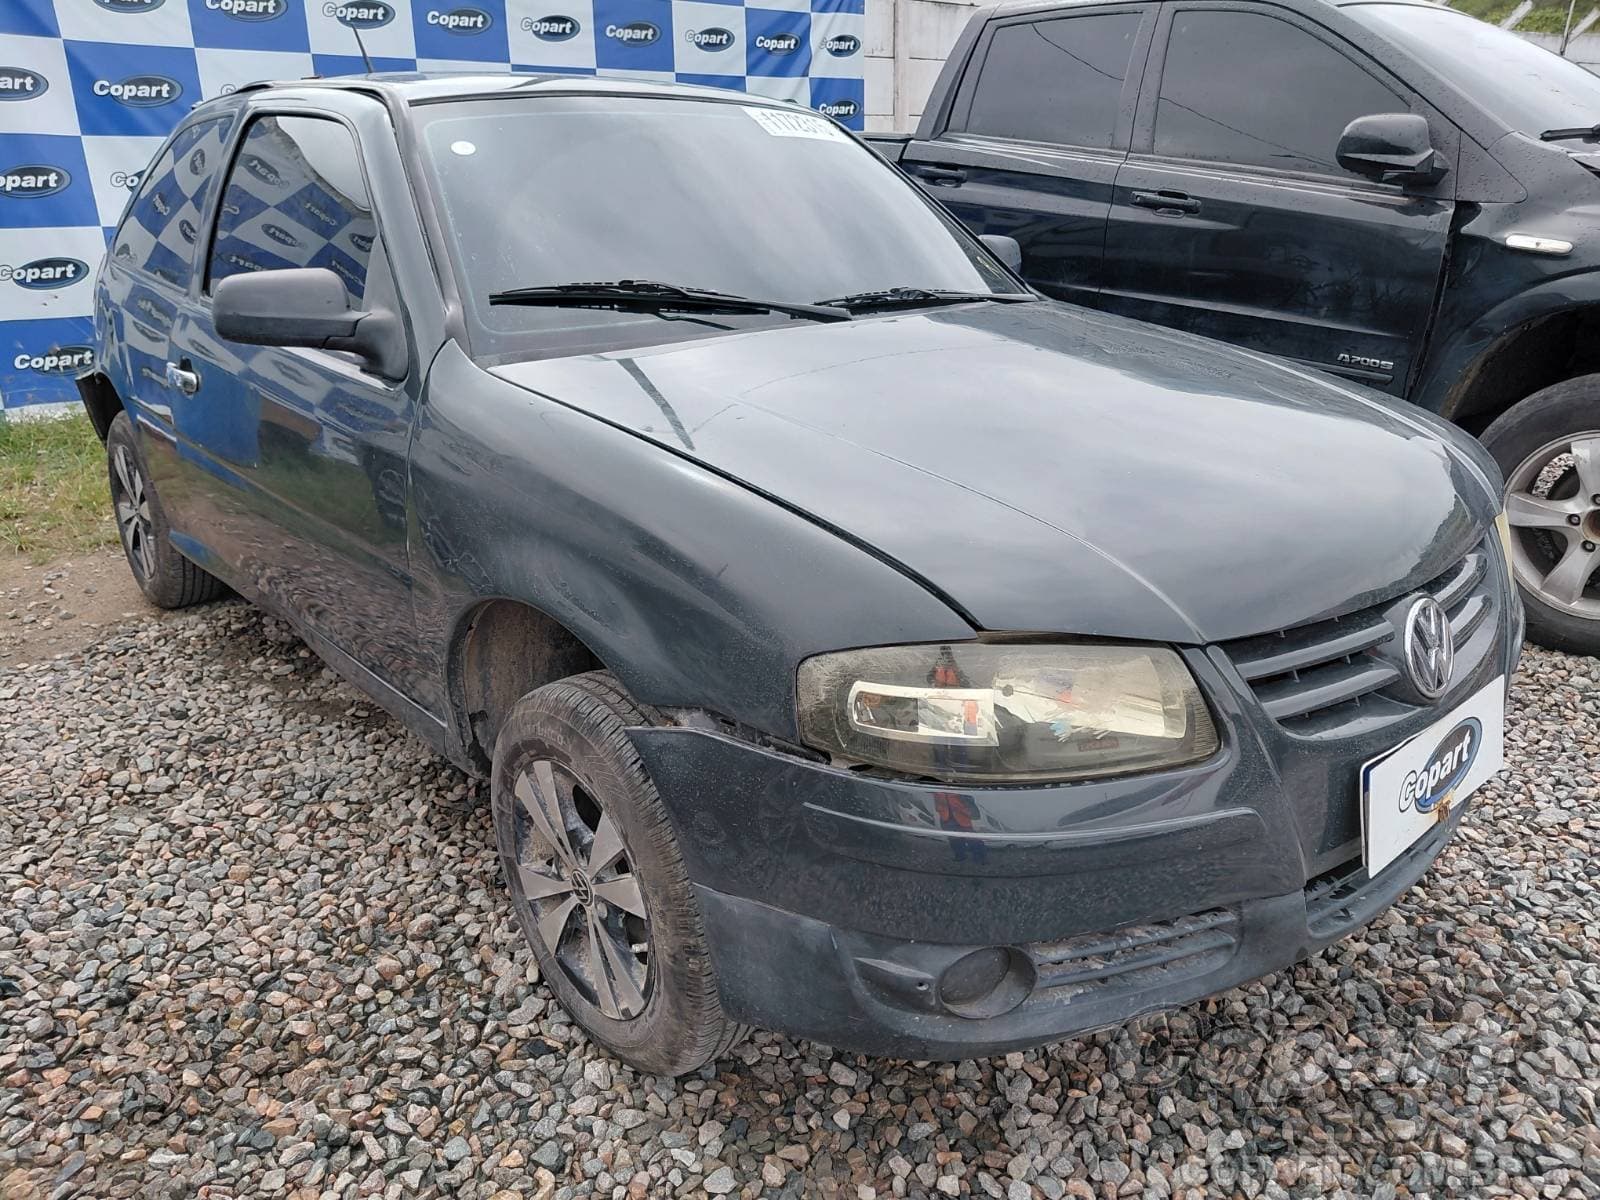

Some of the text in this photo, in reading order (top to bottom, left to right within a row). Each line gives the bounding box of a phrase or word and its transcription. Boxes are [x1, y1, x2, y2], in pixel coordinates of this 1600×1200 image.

[206, 0, 276, 14] Copart
[321, 1, 386, 20] Copart
[426, 11, 485, 28] Copart
[520, 18, 573, 35] Copart
[606, 25, 655, 41] Copart
[684, 29, 729, 46] Copart
[755, 36, 796, 51] Copart
[820, 38, 854, 51] Copart
[0, 76, 34, 91] art
[94, 80, 170, 98] Copart
[818, 103, 854, 118] Copart
[0, 263, 75, 282] Copart
[14, 352, 94, 374] Copart
[1399, 729, 1472, 813] Copart
